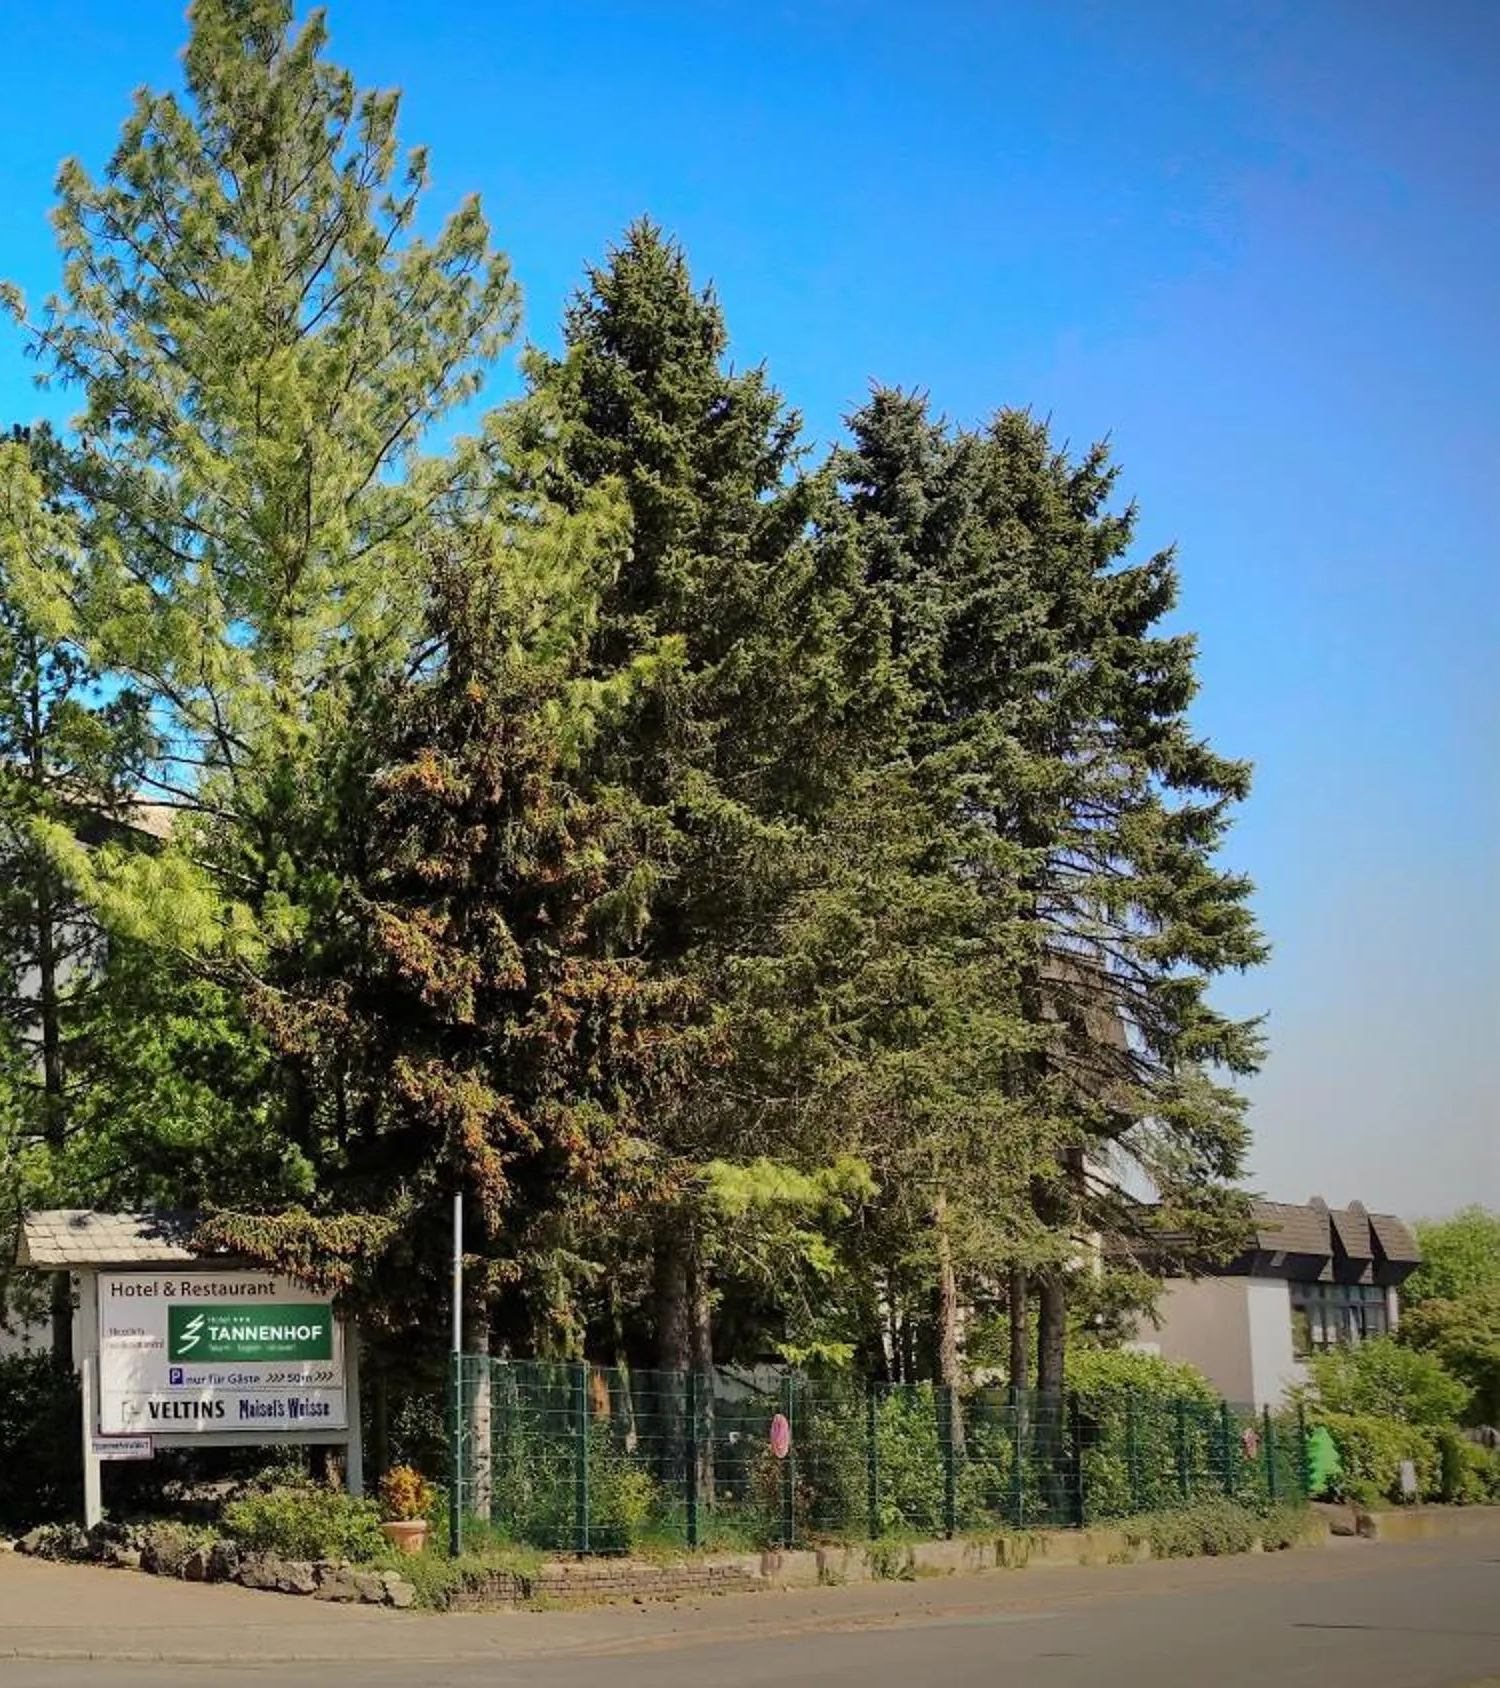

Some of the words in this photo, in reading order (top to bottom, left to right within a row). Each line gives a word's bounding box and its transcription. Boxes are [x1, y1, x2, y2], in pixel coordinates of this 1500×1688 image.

[111, 1281, 158, 1297] Hotel
[163, 1281, 177, 1297] &
[181, 1280, 276, 1297] Restaurant
[208, 1325, 323, 1341] TANNENHOF
[186, 1375, 206, 1385] nur
[209, 1373, 225, 1385] für
[228, 1373, 261, 1385] Gäste
[149, 1400, 225, 1420] VELTINS
[287, 1397, 330, 1419] Weisse
